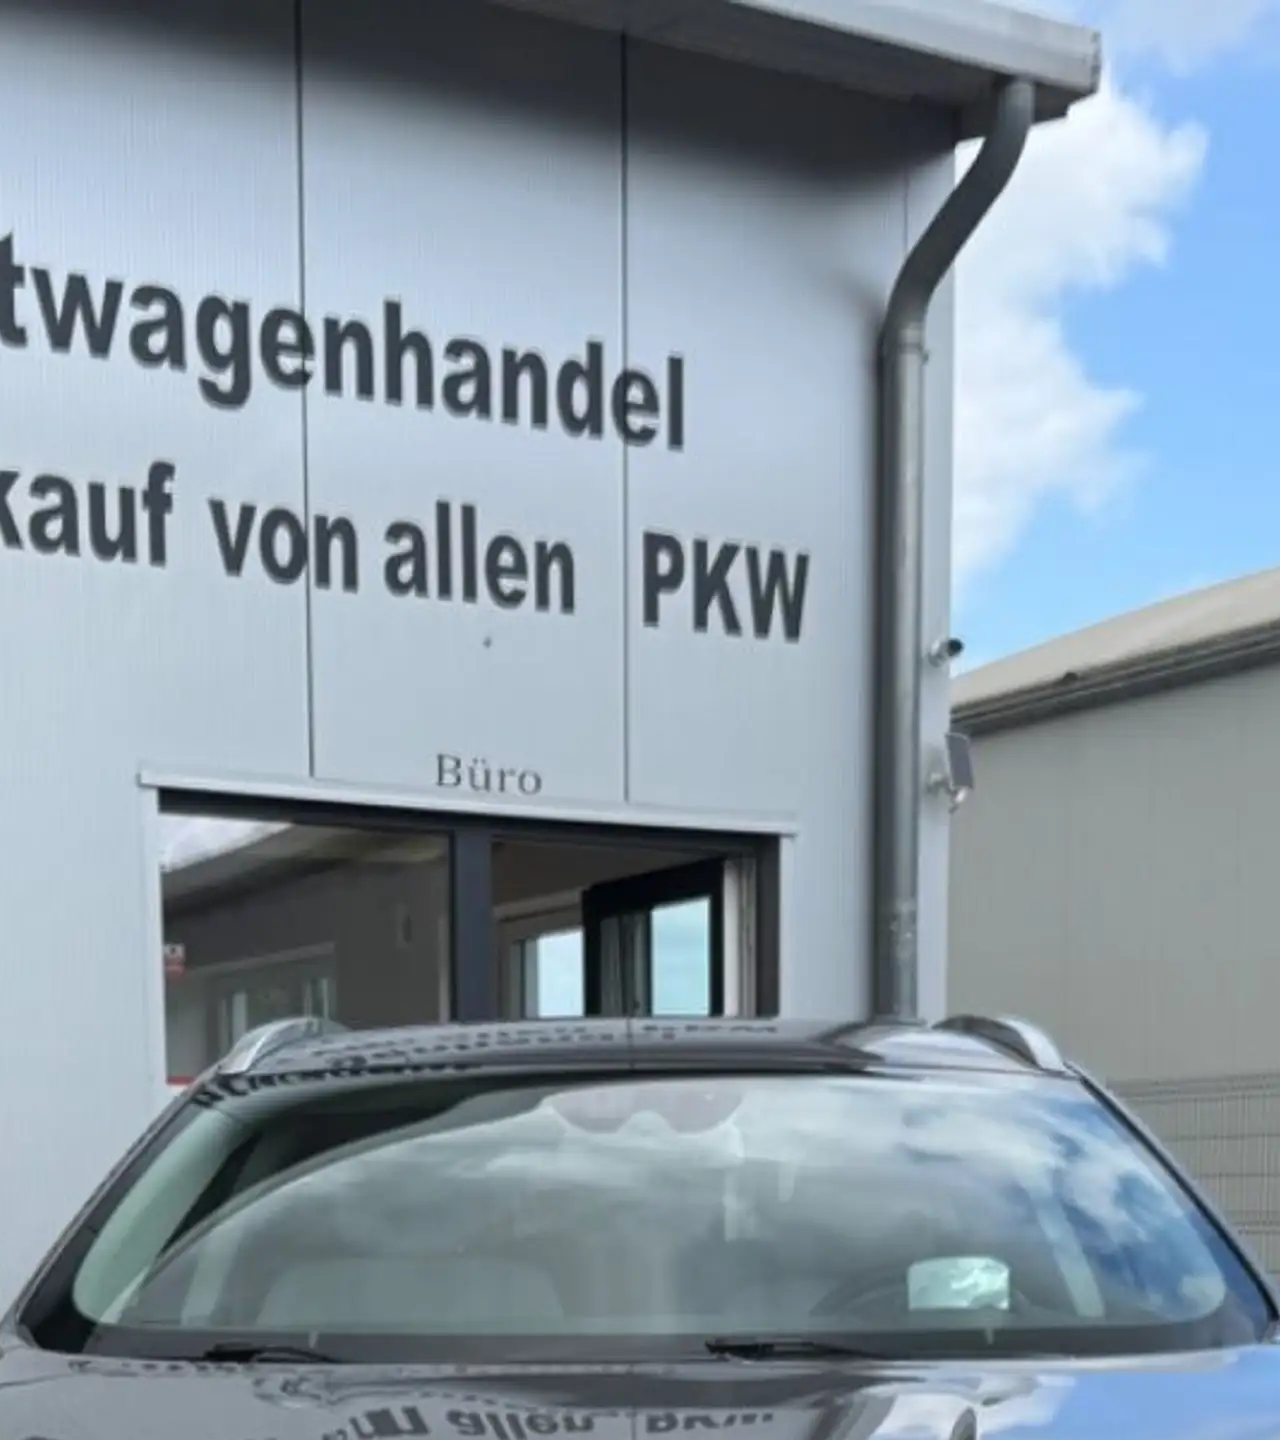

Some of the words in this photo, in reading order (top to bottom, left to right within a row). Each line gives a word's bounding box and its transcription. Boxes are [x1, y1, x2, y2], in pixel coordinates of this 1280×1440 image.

[208, 498, 359, 593] von
[383, 500, 576, 614] allen
[642, 530, 811, 643] PKW
[436, 753, 542, 796] Büro
